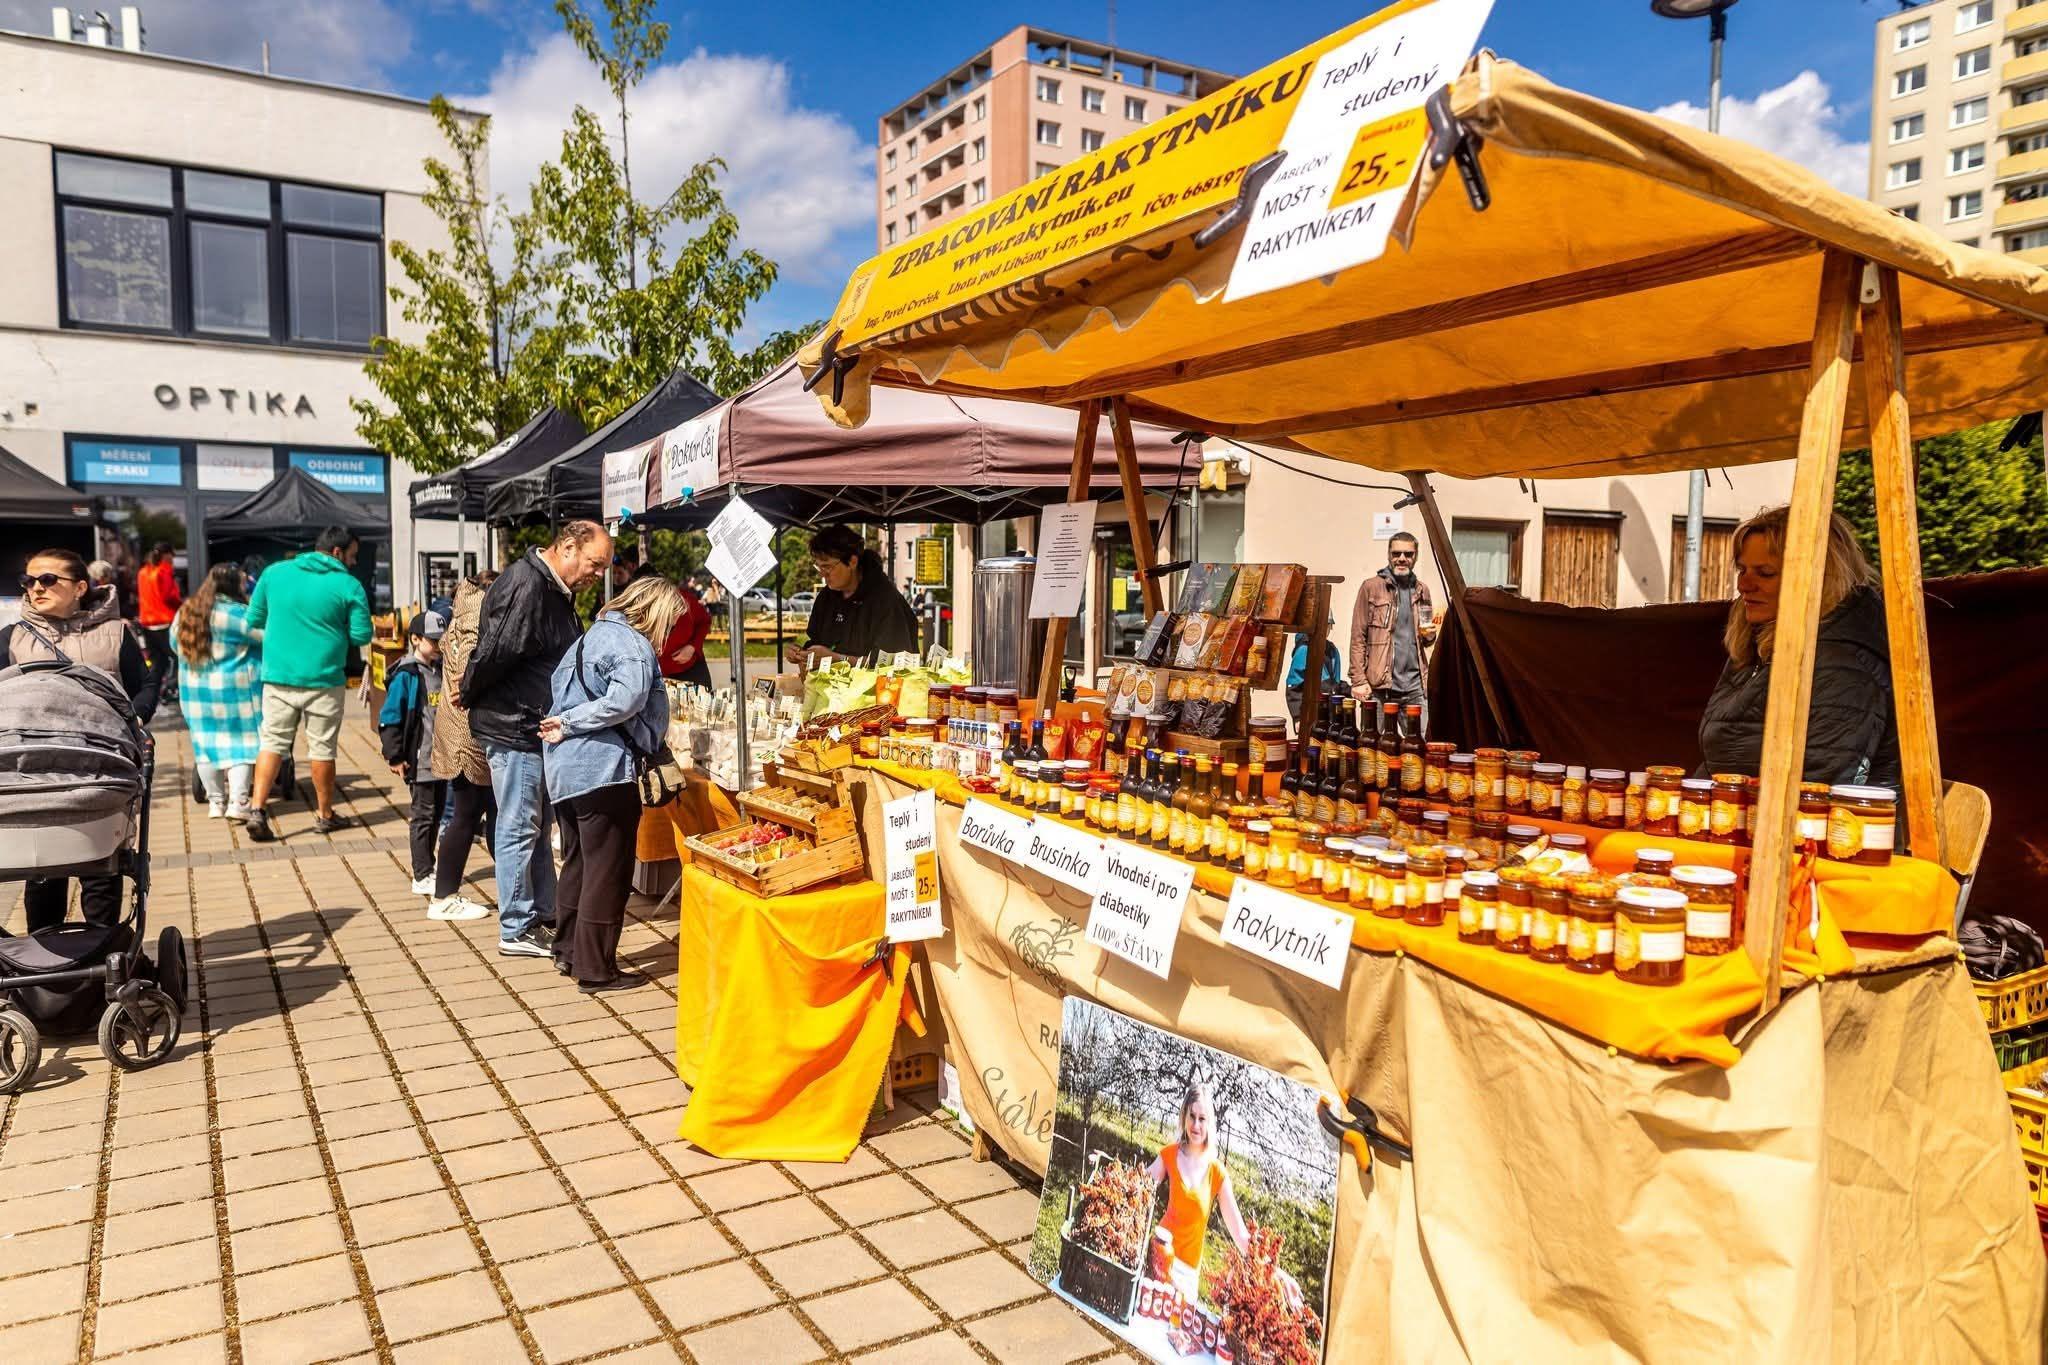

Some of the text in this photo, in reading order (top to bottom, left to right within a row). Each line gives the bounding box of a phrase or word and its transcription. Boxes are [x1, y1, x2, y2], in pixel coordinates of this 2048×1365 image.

[1322, 36, 1405, 88] Teplý i
[1340, 64, 1439, 116] studený
[888, 61, 1313, 279] ZPRACOVÁNÍ RAKYTNÍKU
[1342, 152, 1407, 193] 25,-
[1262, 184, 1329, 219] MOŠT s
[864, 316, 880, 330] Ing.
[882, 303, 906, 320] Pavel
[907, 289, 940, 314] Cvrček
[947, 275, 978, 296] Lhota
[977, 263, 1002, 288] pod
[1002, 245, 1050, 274] Libčany
[1082, 222, 1108, 242] 503
[1112, 213, 1132, 229] 27
[1142, 192, 1178, 217] IČO:
[1182, 165, 1249, 200] 668197
[154, 383, 317, 418] OPTIKA
[100, 448, 152, 462] MĚŘENÍ
[103, 463, 149, 477] ZRAKU
[307, 458, 365, 472] ODBORNÉ
[671, 439, 701, 470] Doktor
[889, 808, 910, 829] Teplý
[961, 816, 1015, 855] Borůvka
[905, 832, 932, 851] studený
[1029, 835, 1091, 879] Brusinka
[890, 865, 916, 882] JABLEČNÝ
[918, 877, 935, 897] 25,-
[1107, 857, 1178, 900] Vhodné i pro
[891, 889, 908, 902] MOŠT
[1099, 891, 1151, 929] diabetiky
[890, 906, 932, 924] RAKYTNÍKEM
[1091, 922, 1163, 969] 100% ŠŤÁVY
[1232, 907, 1331, 965] Rakytník
[1040, 1023, 1060, 1053] RA
